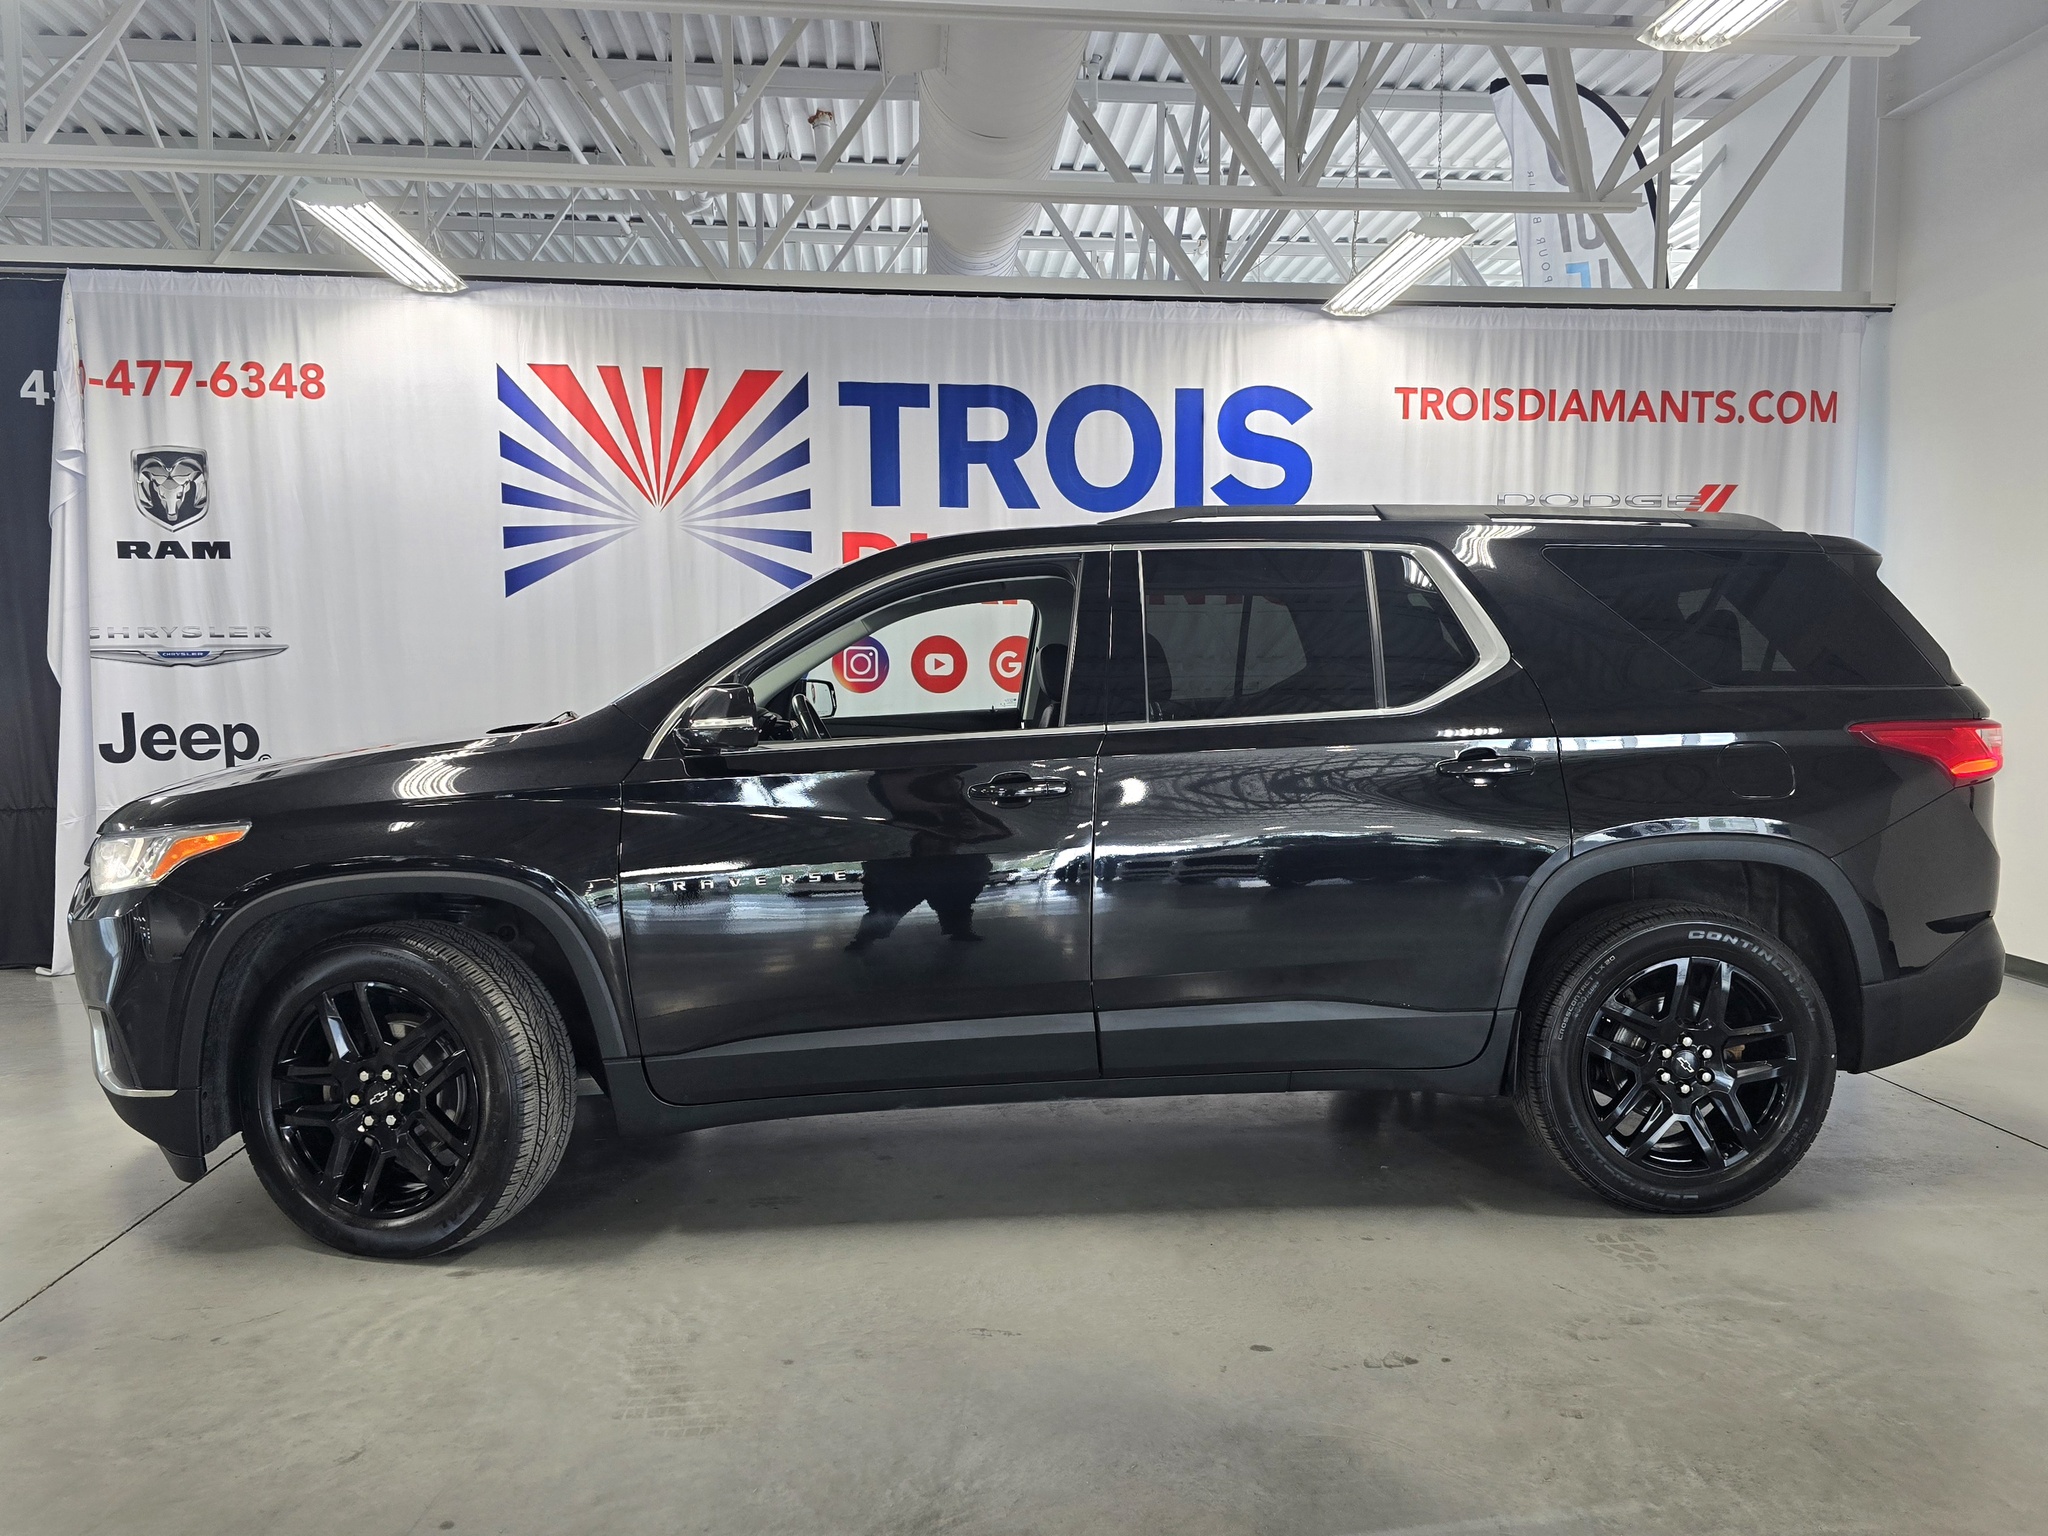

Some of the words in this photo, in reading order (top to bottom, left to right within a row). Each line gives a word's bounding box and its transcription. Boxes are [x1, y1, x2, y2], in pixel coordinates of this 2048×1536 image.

[1394, 387, 1838, 424] TROISDIAMANTS.COM
[838, 381, 1313, 512] TROIS
[1496, 493, 1702, 509] DODGE
[116, 540, 231, 559] RAM
[98, 711, 260, 768] Jeep
[648, 870, 847, 892] TRAVERSE
